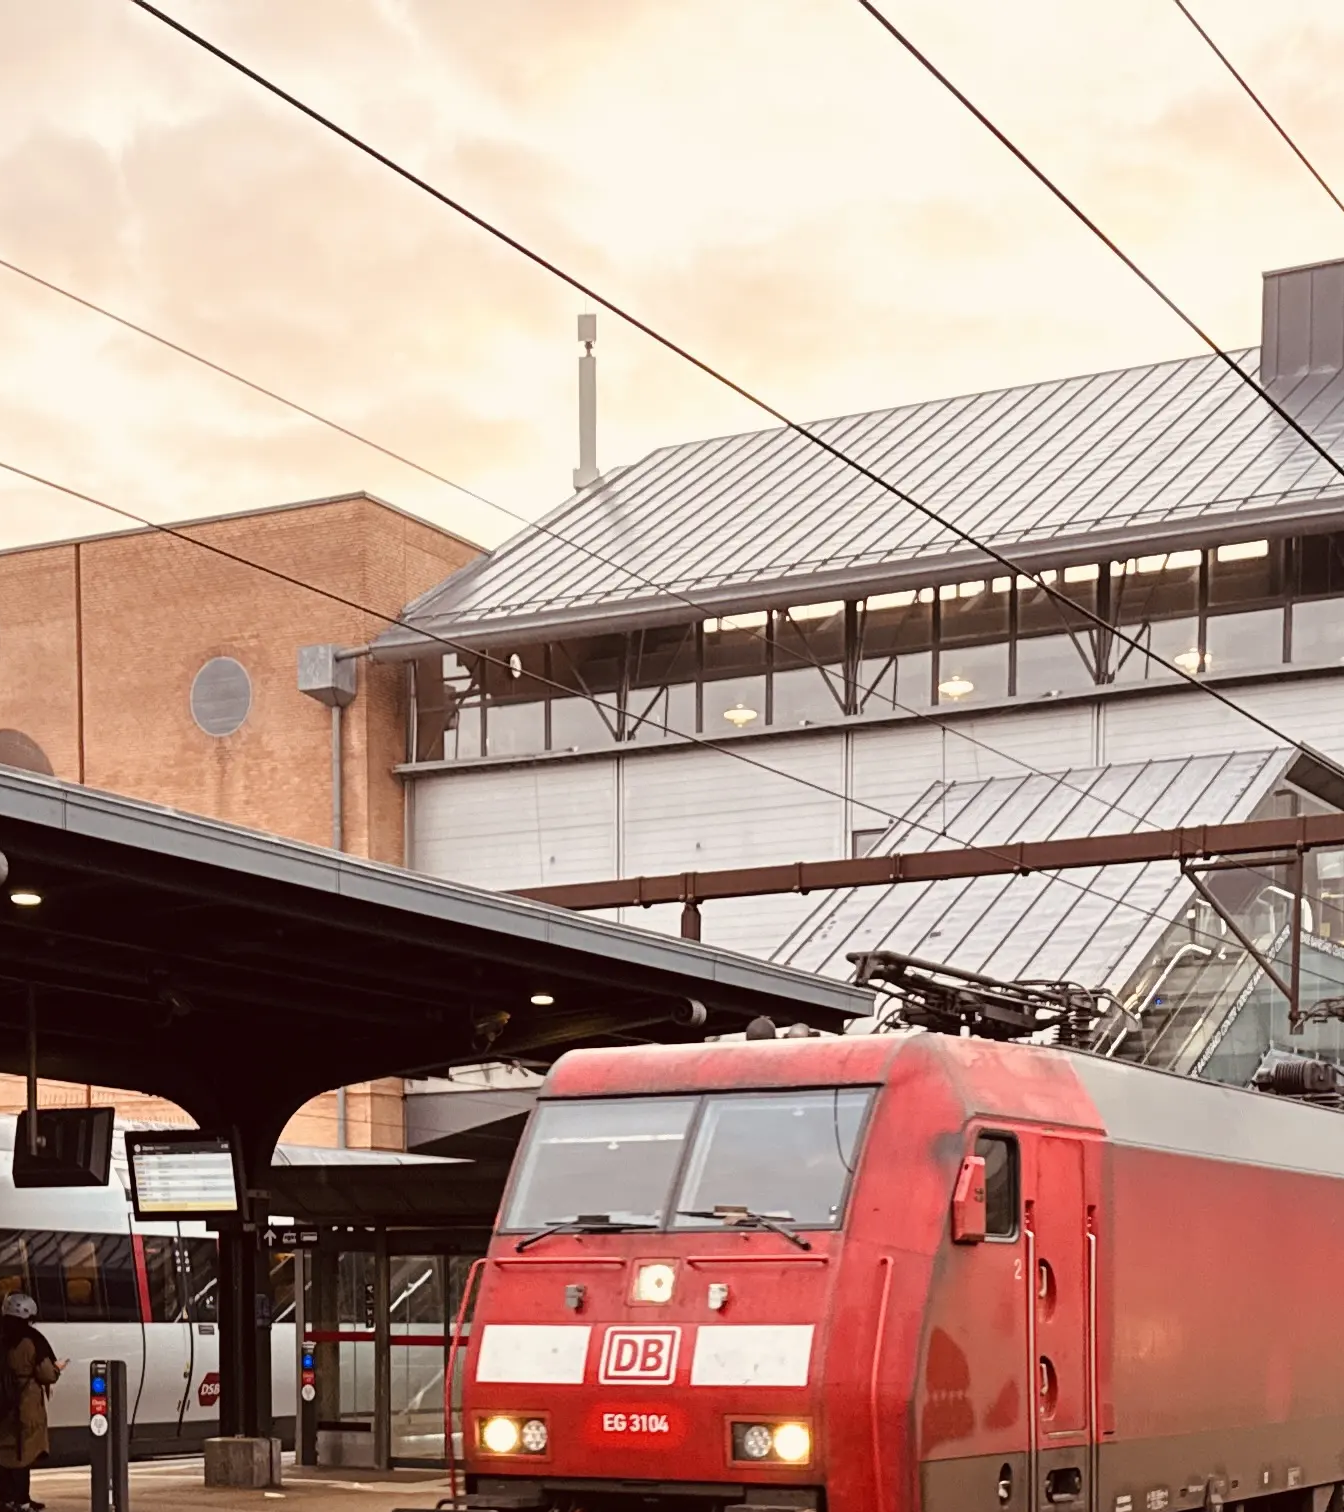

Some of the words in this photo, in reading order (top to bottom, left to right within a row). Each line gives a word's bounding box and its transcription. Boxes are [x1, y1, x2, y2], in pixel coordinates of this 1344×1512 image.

[1014, 1258, 1022, 1280] 2
[613, 1338, 664, 1372] DB
[200, 1383, 220, 1396] DSB
[602, 1413, 628, 1432] EG
[629, 1413, 670, 1433] 3104
